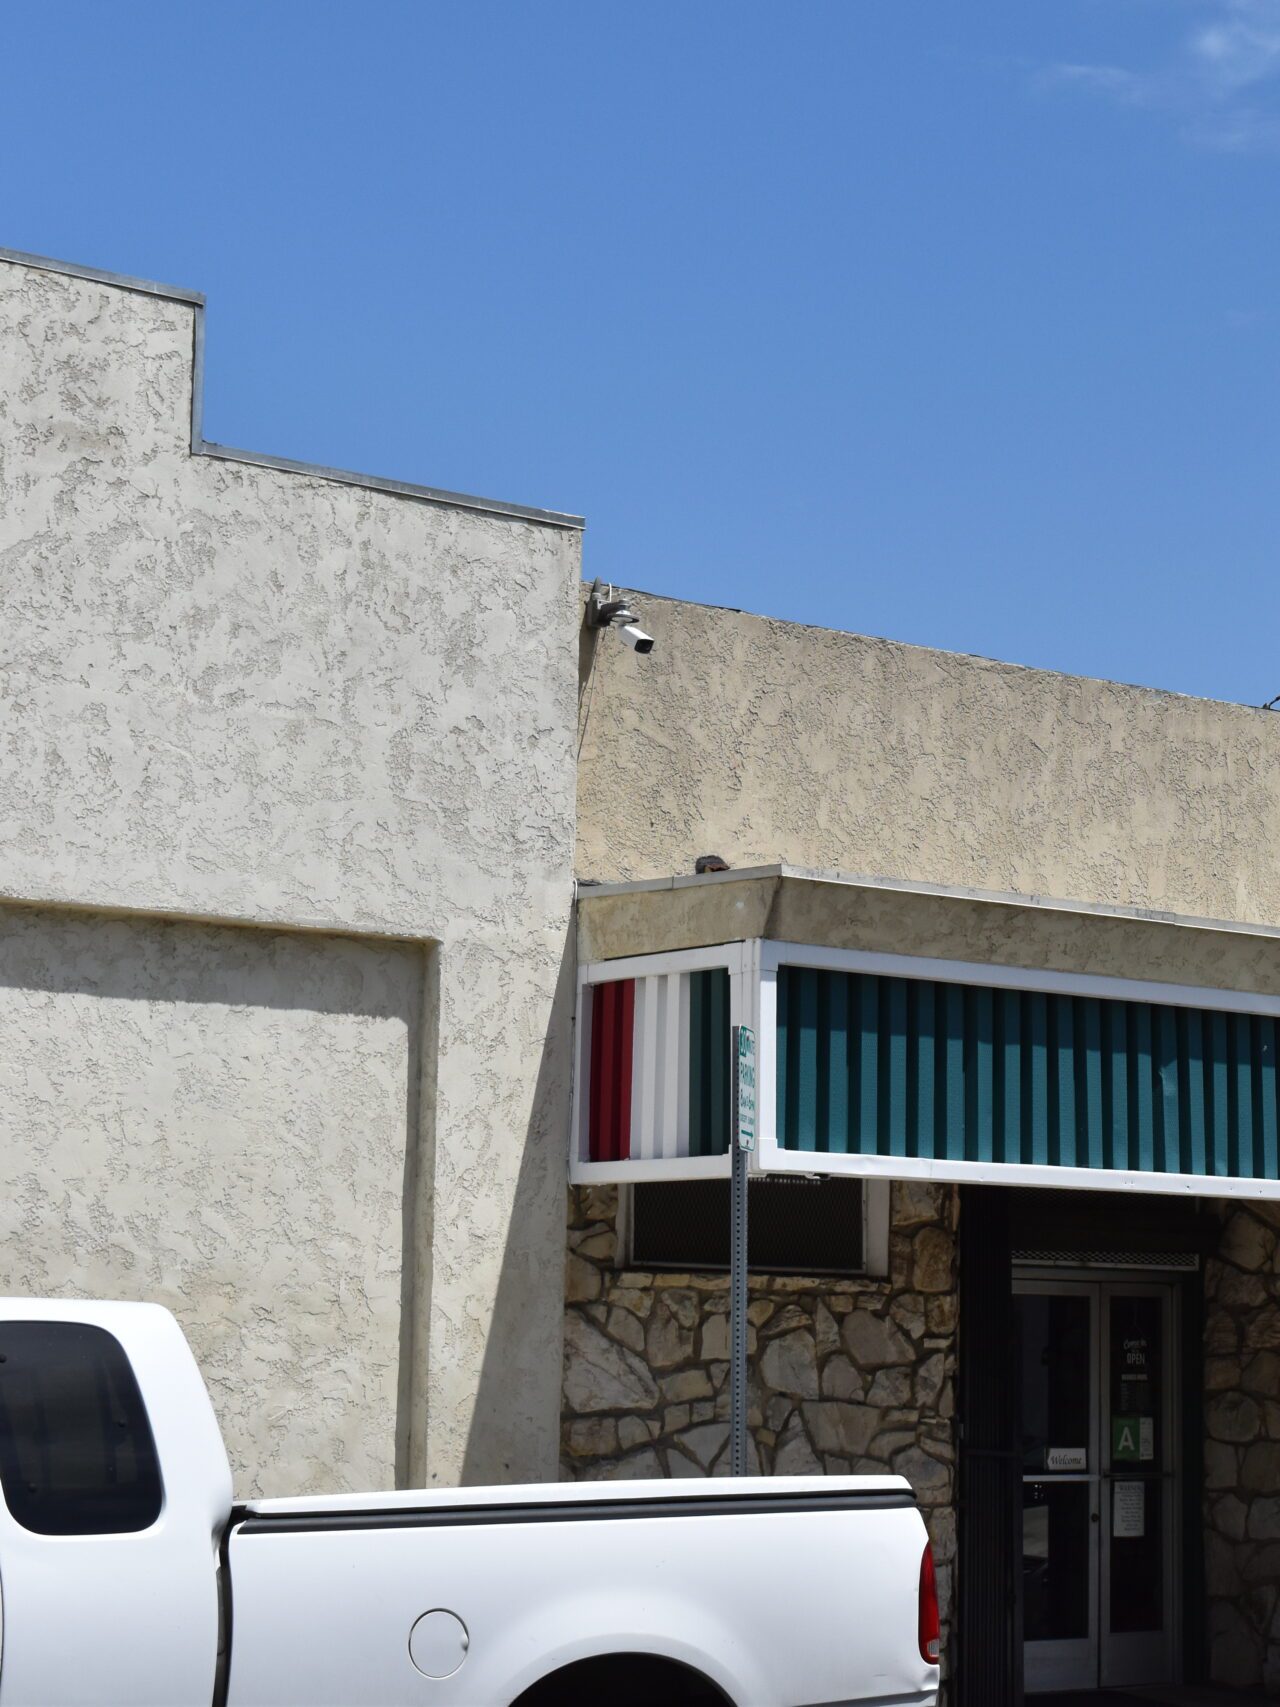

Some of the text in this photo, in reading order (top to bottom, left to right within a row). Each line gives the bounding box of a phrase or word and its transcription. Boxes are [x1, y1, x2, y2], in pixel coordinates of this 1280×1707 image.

[1126, 1353, 1145, 1365] OPEN
[1118, 1426, 1135, 1450] A
[1050, 1455, 1082, 1465] Welcome
